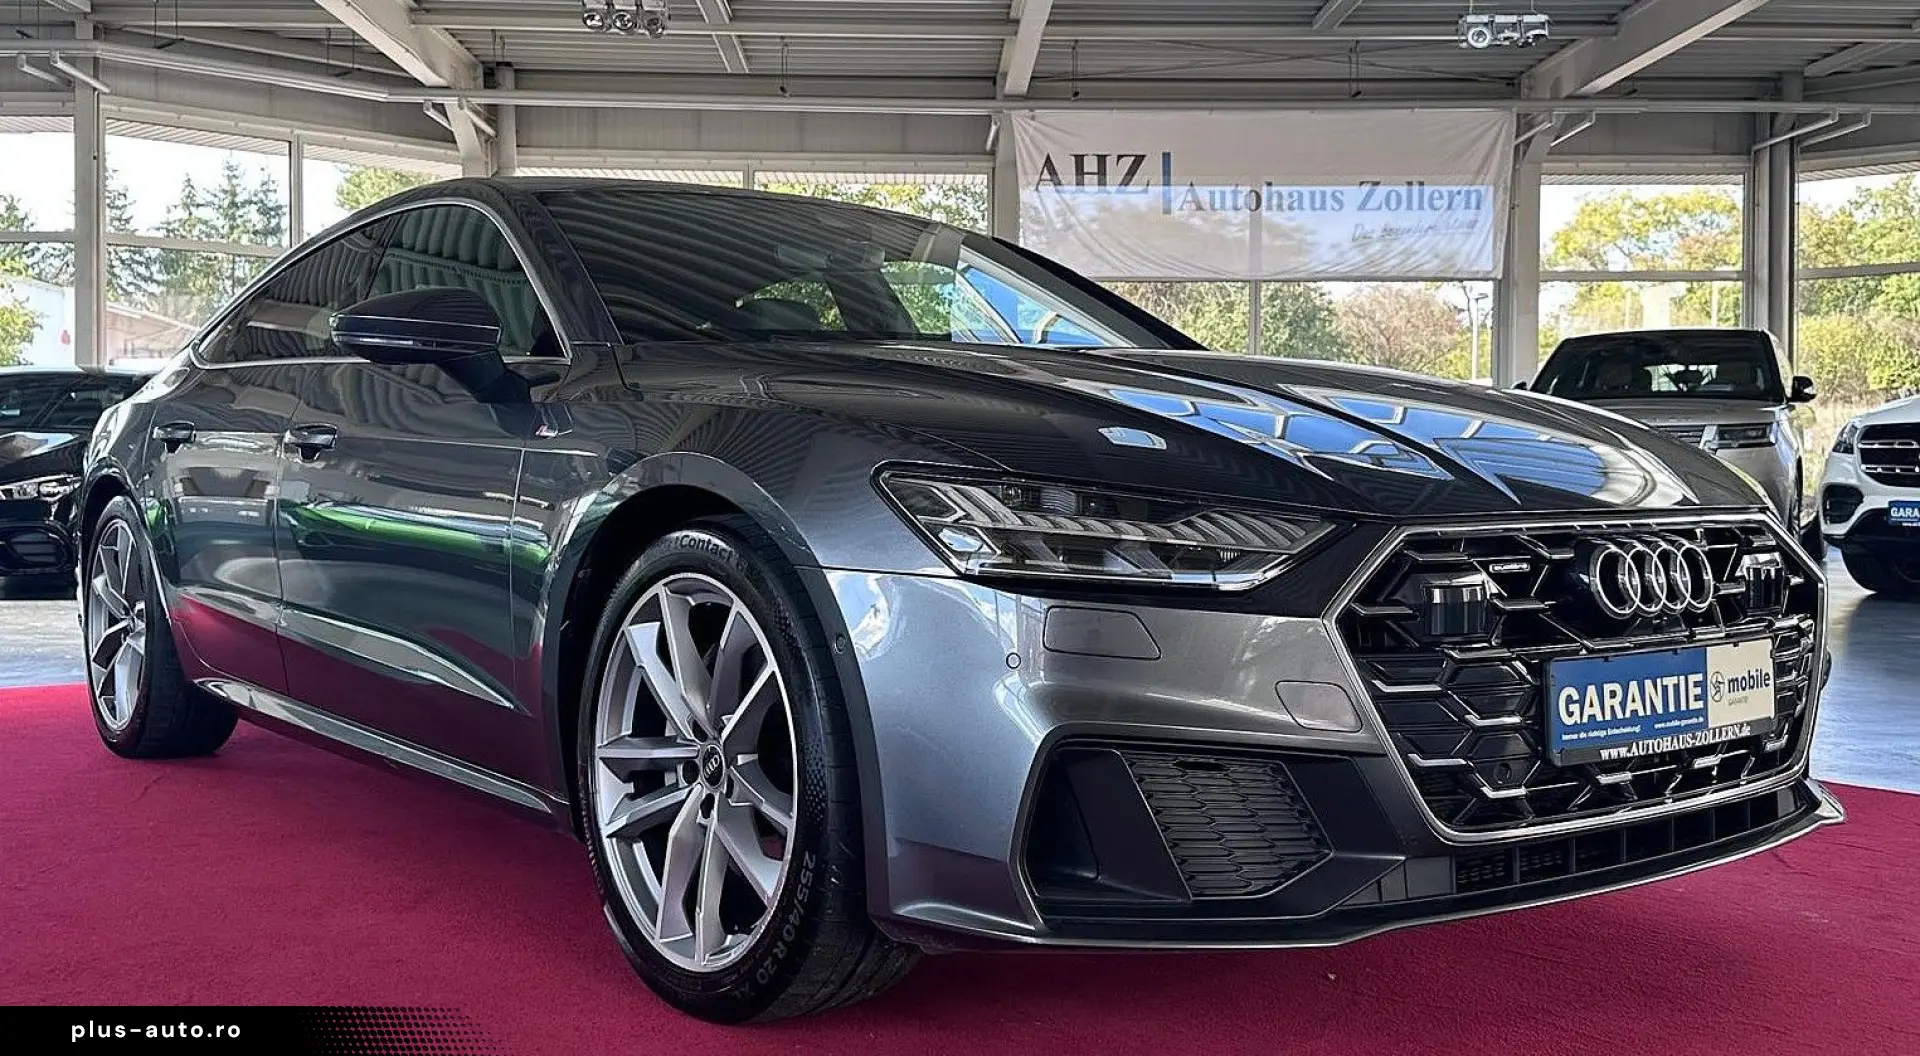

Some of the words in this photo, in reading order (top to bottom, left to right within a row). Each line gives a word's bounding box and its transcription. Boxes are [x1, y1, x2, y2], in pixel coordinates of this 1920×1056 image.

[1035, 152, 1150, 195] AHZ
[1178, 180, 1345, 212] Autohaus
[1357, 180, 1483, 212] Zollern
[1558, 672, 1704, 726] GARANTIE
[1727, 668, 1771, 694] mobile
[1600, 723, 1751, 761] www.AUTOHAUS-ZOLLERN.de
